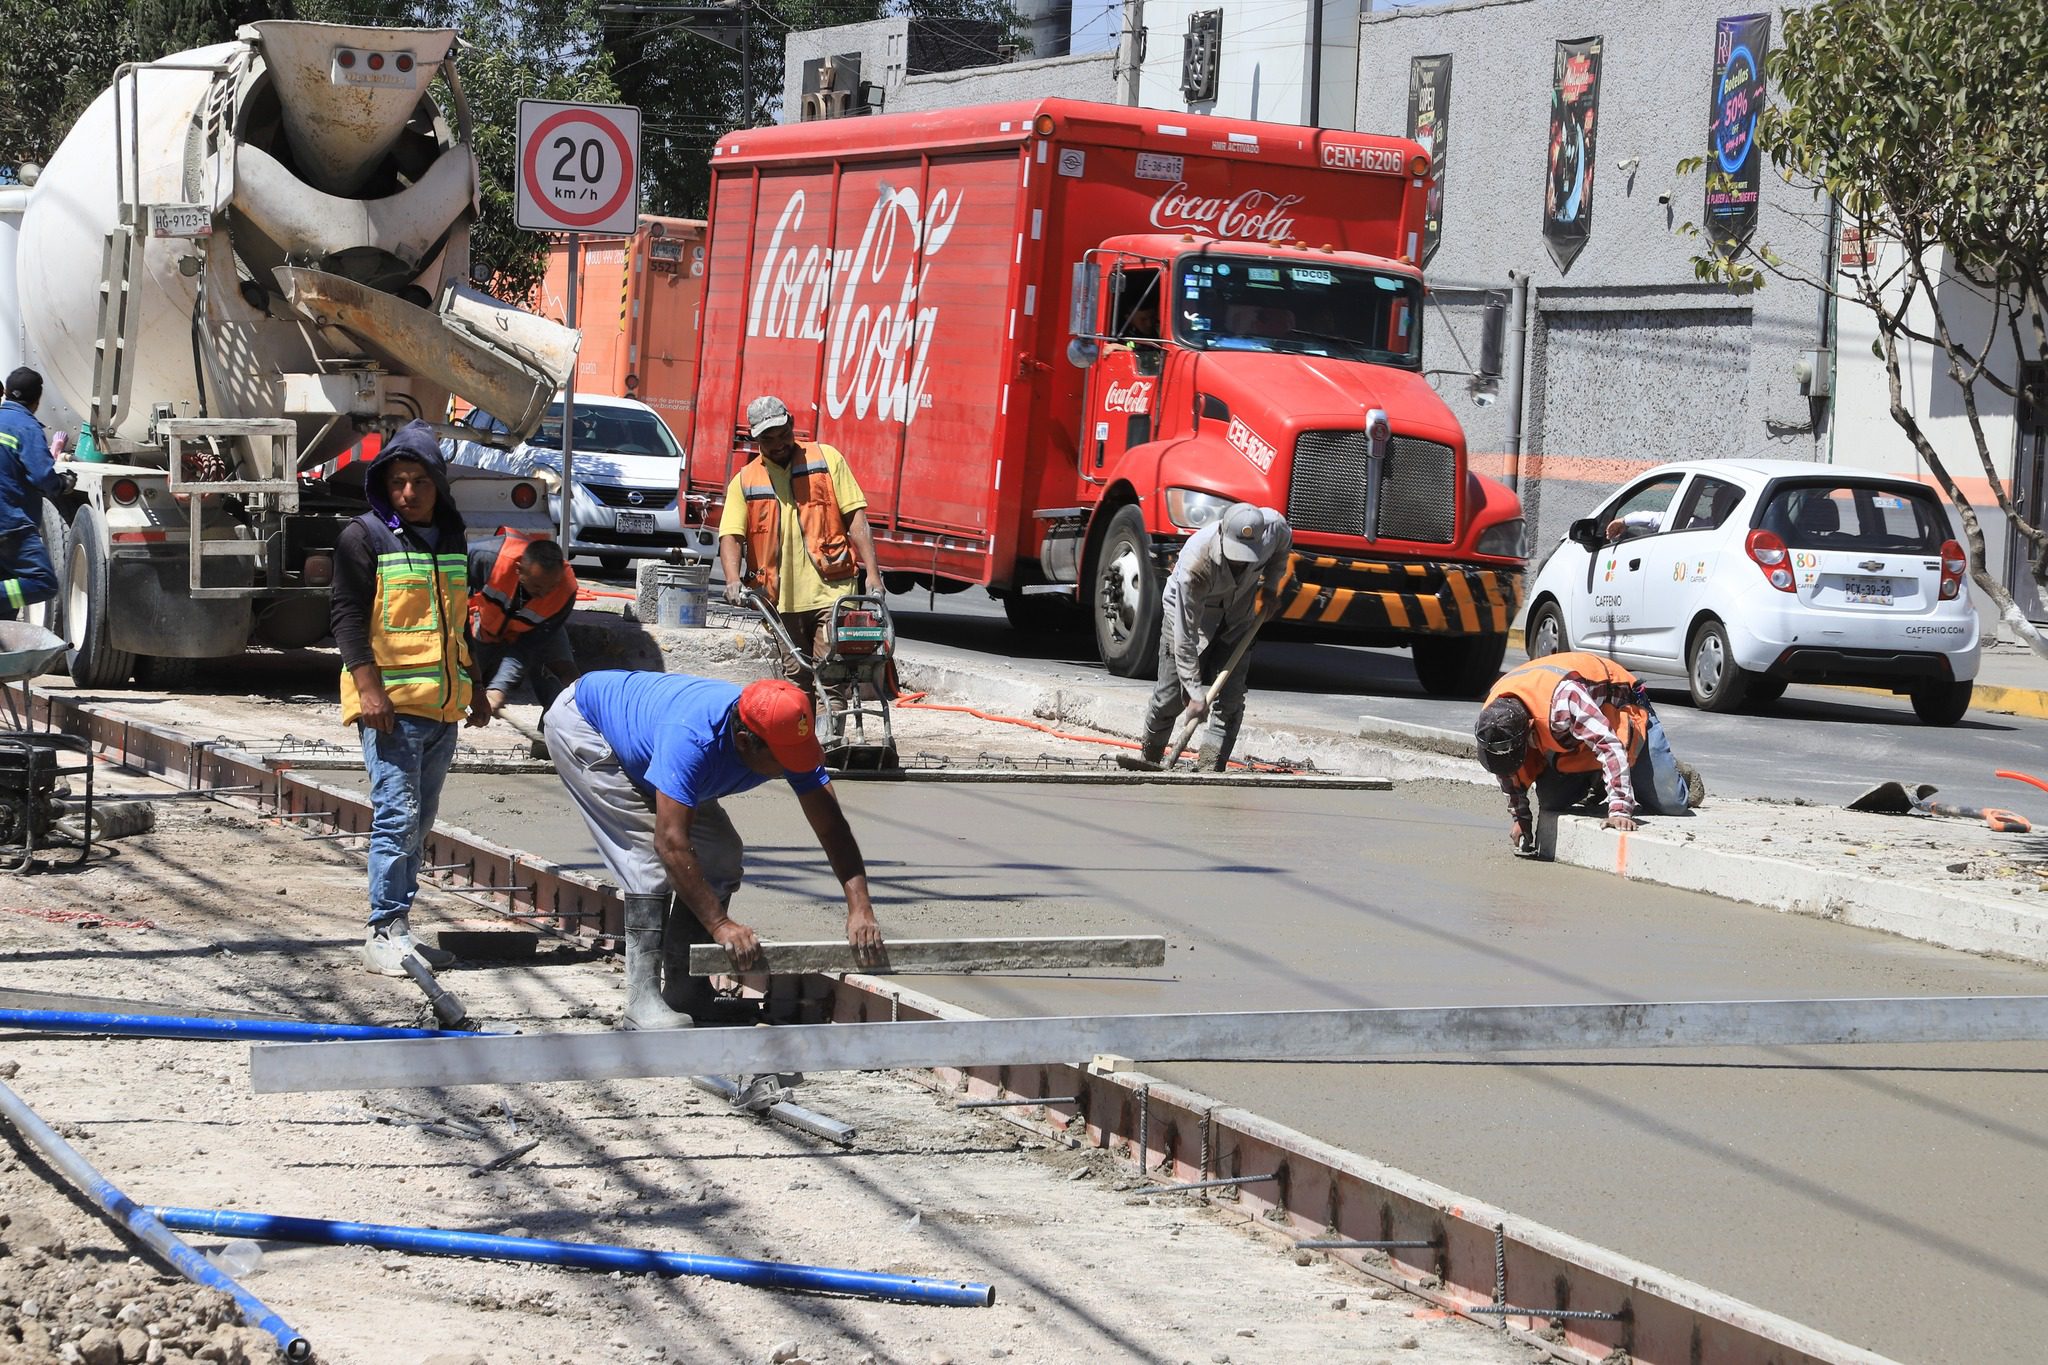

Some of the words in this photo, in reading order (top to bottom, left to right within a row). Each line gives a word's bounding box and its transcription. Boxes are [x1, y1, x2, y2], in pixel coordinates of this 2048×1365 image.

[1725, 88, 1748, 126] 50%
[552, 137, 605, 184] 20
[1323, 145, 1401, 172] CEN-16206
[1138, 160, 1182, 174] LE-36-815
[555, 187, 598, 201] km/h
[1150, 182, 1305, 241] Coca-Cola
[155, 213, 210, 229] HG-9123-E
[651, 261, 679, 274] 5521
[1105, 381, 1152, 414] Coca-Cola
[1228, 420, 1274, 470] CEN-16206
[1797, 553, 1817, 568] 80
[1673, 562, 1686, 582] 80
[1845, 583, 1891, 596] PCX-39-29
[1595, 595, 1622, 607] CAFFENIO
[1906, 626, 1965, 635] CAFFENIO.COM
